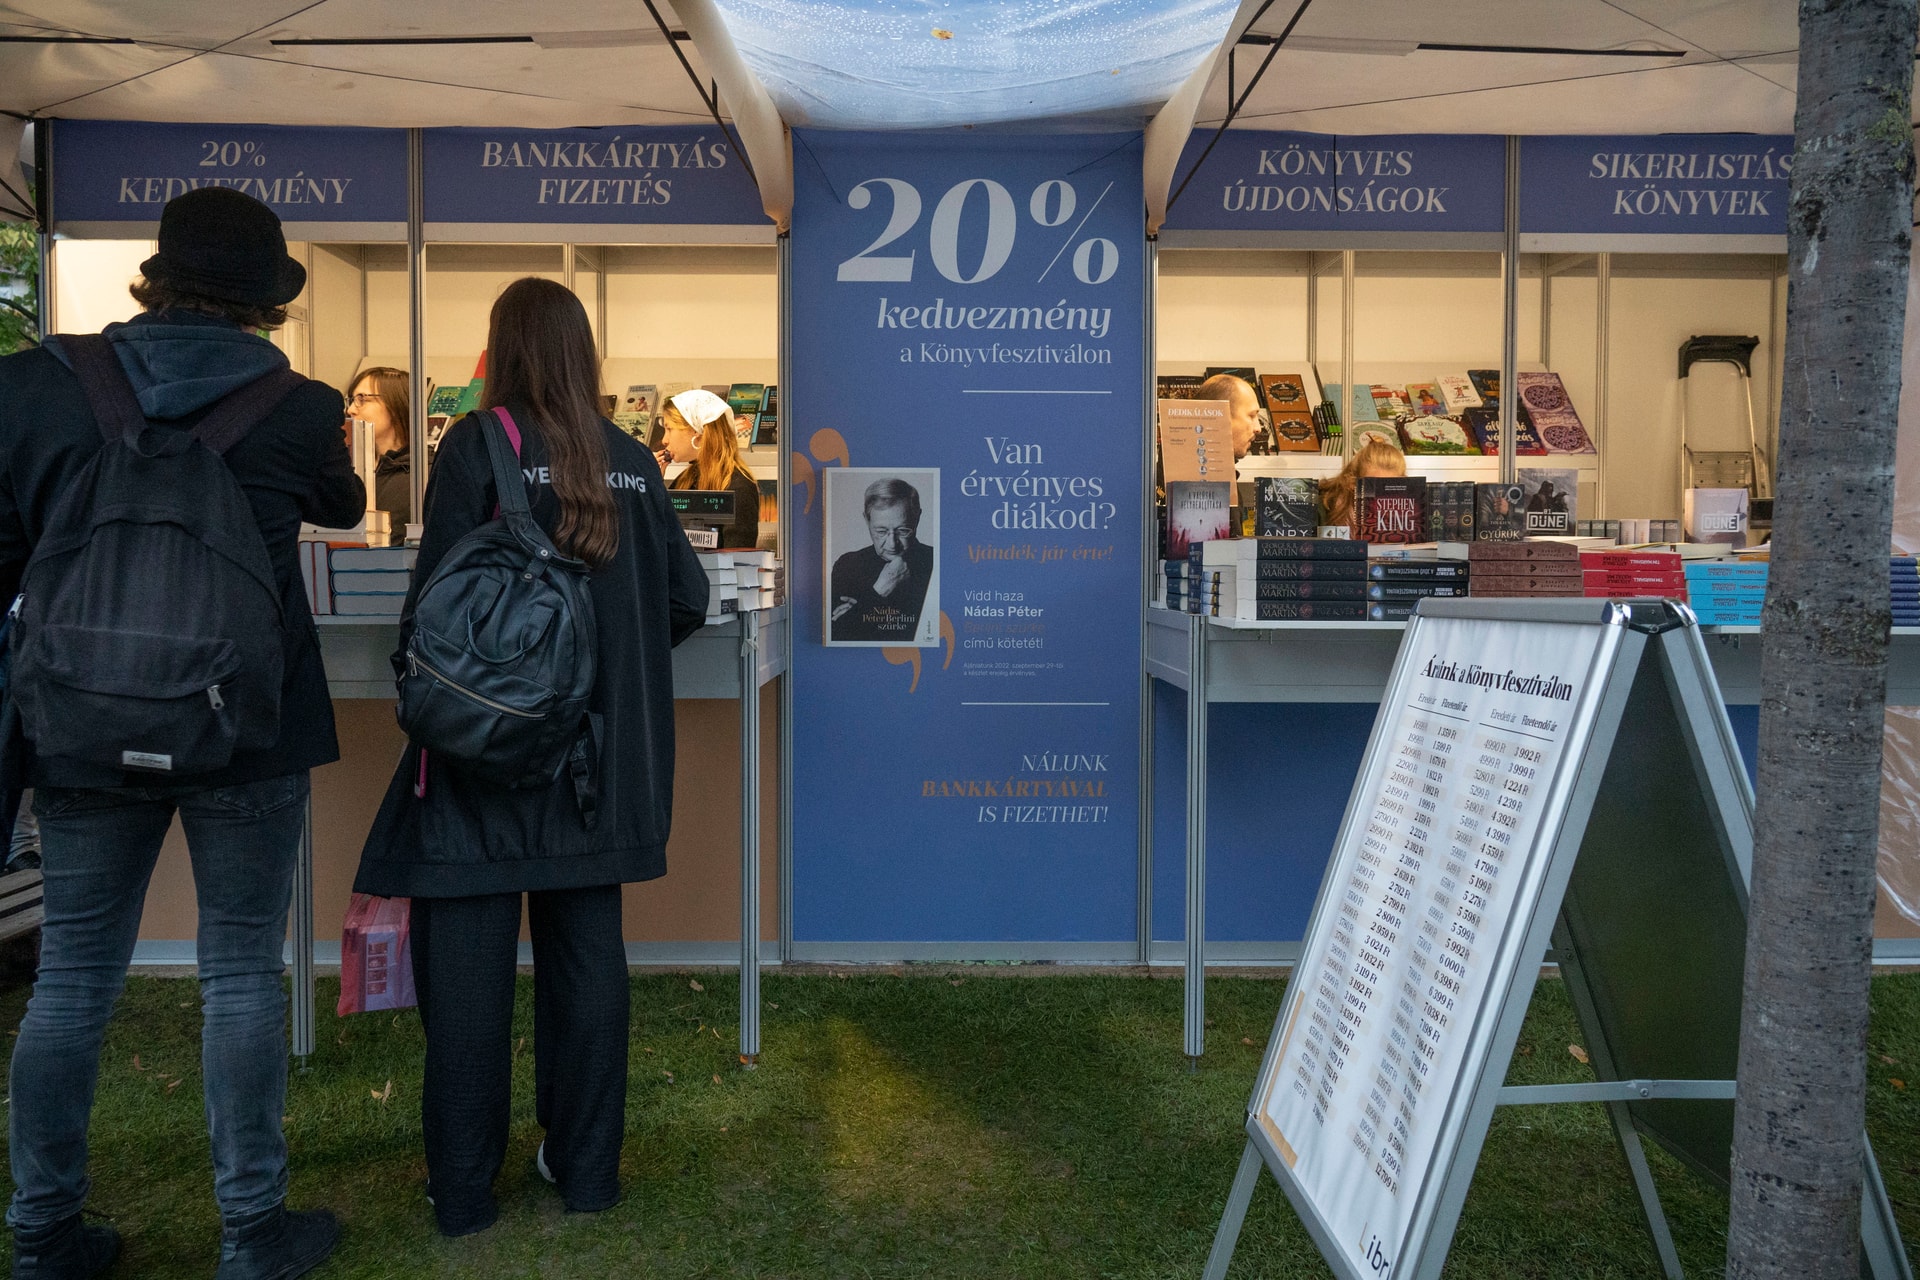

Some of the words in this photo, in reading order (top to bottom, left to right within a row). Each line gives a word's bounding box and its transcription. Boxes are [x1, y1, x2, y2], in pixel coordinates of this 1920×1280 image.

[200, 140, 266, 167] 20%
[481, 136, 727, 169] BANKKÁRTYÁS
[1257, 146, 1413, 178] KÖNYVES
[1589, 147, 1794, 180] SIKERLISTÁS
[537, 173, 672, 206] FIZETÉS
[1222, 180, 1449, 215] ÚJDONSÁGOK
[1612, 184, 1772, 217] KÖNYVEK
[836, 177, 1120, 285] 20%
[877, 297, 1112, 339] kedvezmény
[900, 348, 912, 363] a
[920, 342, 1112, 368] Könyvfesztiválon
[1168, 407, 1224, 417] DEDIKÁLÁSOK
[984, 436, 1044, 465] Van
[960, 469, 1103, 504] érvényes
[1264, 486, 1310, 495] HAIL
[1264, 494, 1309, 502] MARY
[1376, 498, 1415, 510] STEPHEN
[991, 501, 1116, 530] diákod?
[1376, 509, 1415, 532] KING
[1264, 529, 1309, 537] ANDY
[964, 543, 1038, 564] Ajándék
[1040, 544, 1067, 564] jár
[1072, 543, 1114, 560] érte!
[1262, 549, 1298, 557] MARTIN
[1261, 569, 1297, 577] MARTIN
[964, 590, 991, 601] Vidd
[995, 590, 1024, 601] haza
[1260, 589, 1297, 597] MARTIN
[873, 606, 901, 615] Nádas
[964, 606, 1004, 617] Nádas
[1008, 606, 1044, 617] Péter
[1261, 609, 1297, 617] MARTIN
[863, 614, 885, 623] Péter
[886, 614, 916, 623] Berlini
[963, 637, 994, 649] című
[997, 637, 1044, 649] kötetét!
[1420, 653, 1456, 683] Áraink
[1465, 664, 1573, 702] Könyvfesztiválon
[1490, 708, 1511, 721] Eredeti
[1521, 714, 1551, 730] Fizetendő
[1021, 750, 1108, 772] NÁLUNK
[1389, 771, 1408, 784] 2490
[921, 776, 1108, 798] BANKKÁRTYÁVAL
[1379, 797, 1397, 810] 2699
[977, 806, 997, 823] IS
[1002, 806, 1108, 823] FIZETHET!
[1373, 810, 1391, 823] 2790
[1368, 822, 1386, 837] 2990
[1364, 836, 1380, 849] 2999
[1412, 860, 1420, 871] Ft
[1398, 903, 1406, 914] Ft
[1393, 917, 1401, 929] Ft
[1388, 931, 1396, 943] Ft
[1375, 959, 1384, 971] Ft
[1363, 987, 1372, 998] Ft
